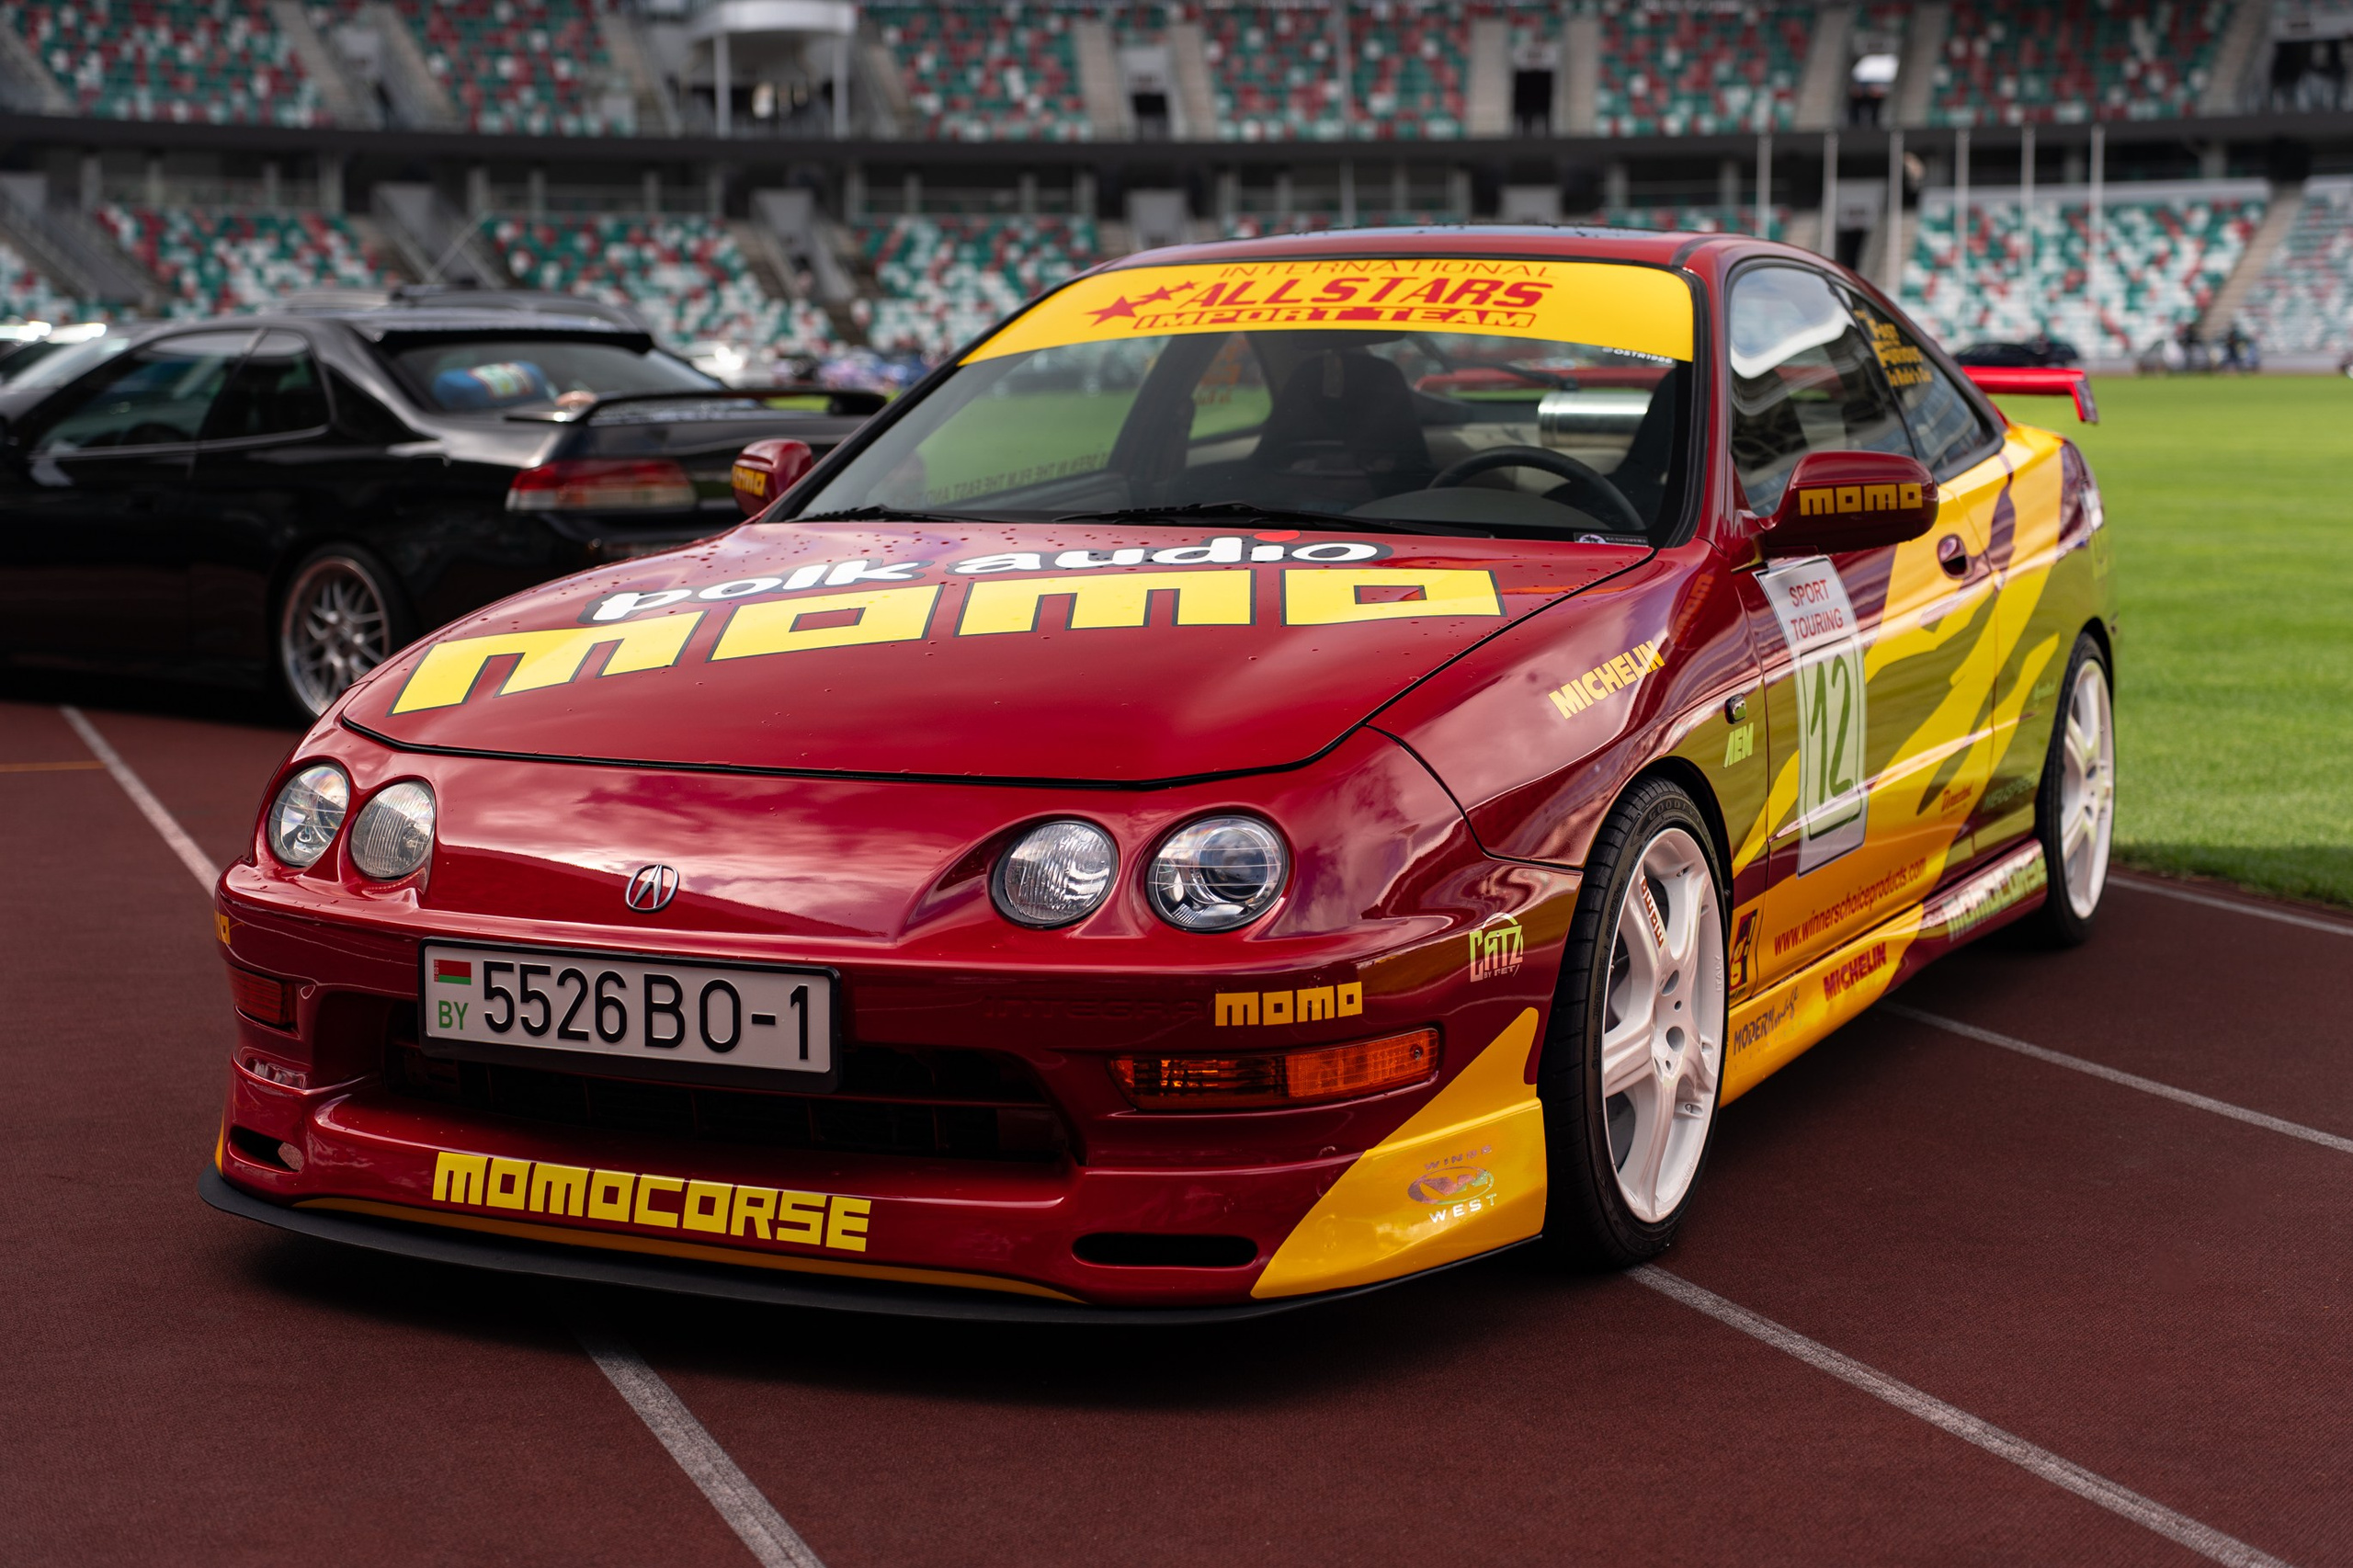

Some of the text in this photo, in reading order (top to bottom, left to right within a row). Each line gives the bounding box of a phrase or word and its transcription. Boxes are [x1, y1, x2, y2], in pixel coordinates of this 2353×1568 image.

[1220, 260, 1558, 278] INTERNATIONAL
[1176, 277, 1553, 309] ALLSTARS
[1137, 307, 1537, 329] IMPORT TEAM
[592, 530, 1379, 622] polk audio
[1789, 579, 1829, 608] SPORT
[386, 568, 1507, 717] momo
[1790, 608, 1844, 641] TOURING
[1548, 641, 1665, 720] MICHELIN
[1723, 722, 1754, 769] AEM
[1810, 653, 1853, 805] 12
[1774, 857, 1927, 957] www.winnerschoiceproducts.com
[1469, 925, 1523, 983] CATZ
[1823, 941, 1887, 1002] MICHELIN
[438, 1000, 470, 1030] BY
[983, 994, 1206, 1020] INTEGRA
[431, 1151, 871, 1252] MOMOCORSE
[1428, 1192, 1497, 1223] WEST
